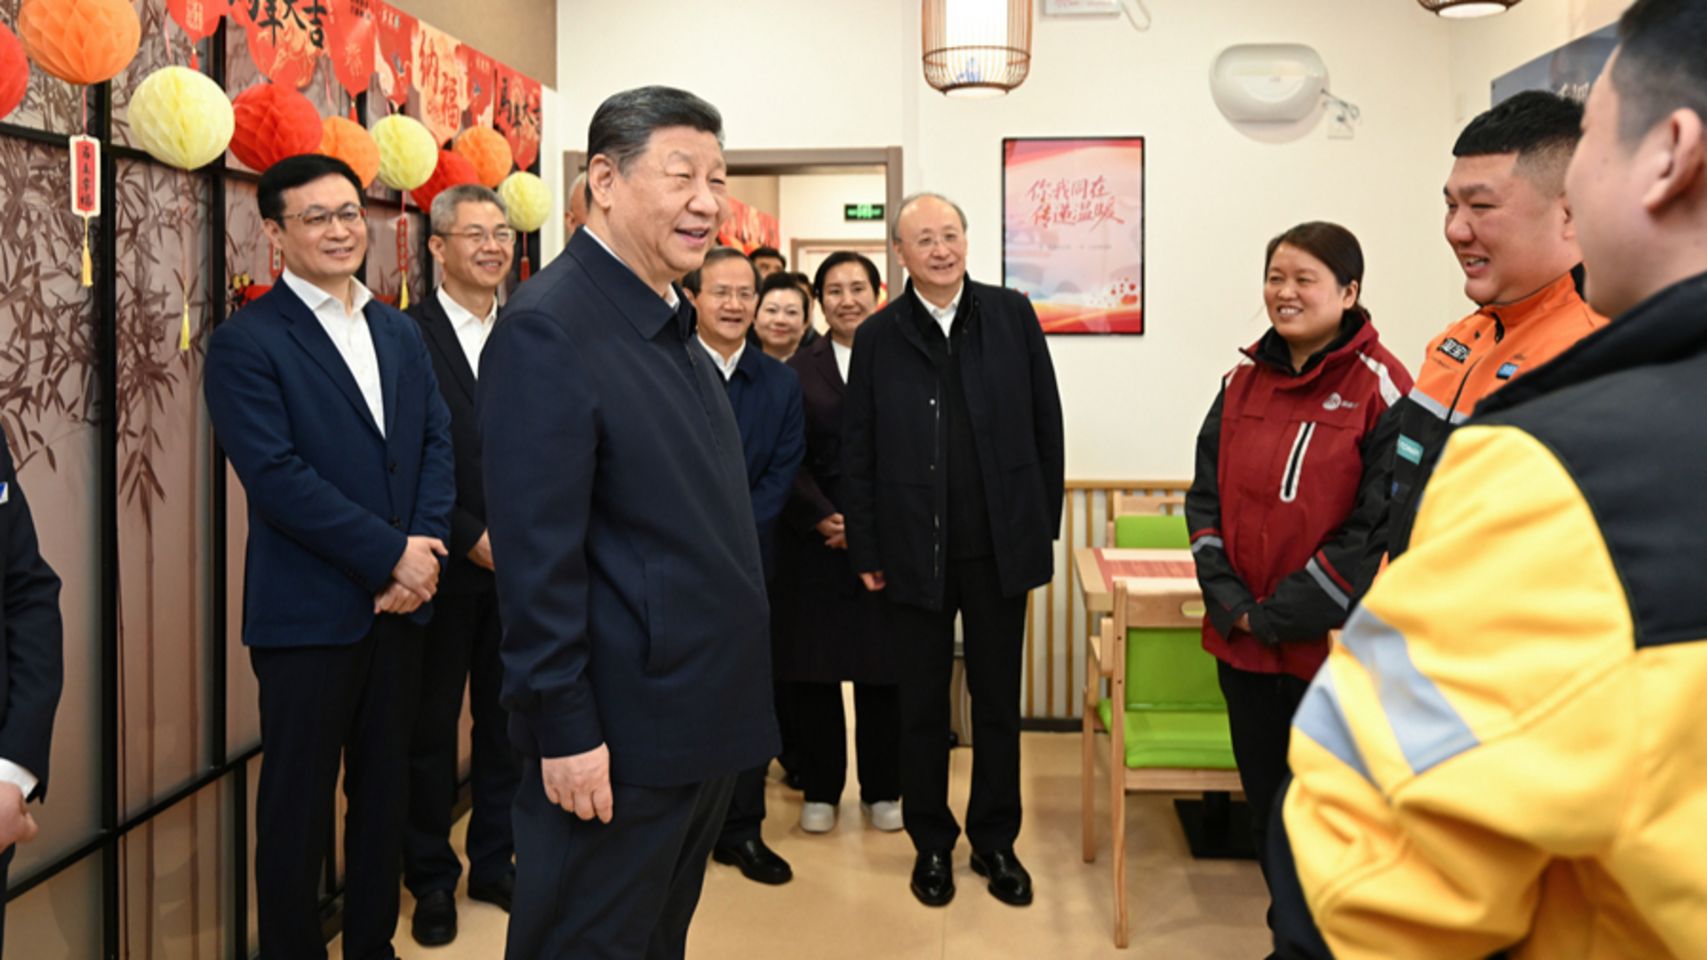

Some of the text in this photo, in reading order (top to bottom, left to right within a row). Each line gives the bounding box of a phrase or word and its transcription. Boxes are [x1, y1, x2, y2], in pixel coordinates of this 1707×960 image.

[419, 29, 459, 130] 纳福
[1028, 174, 1111, 203] 你我同在
[1032, 196, 1125, 232] 传递温暖
